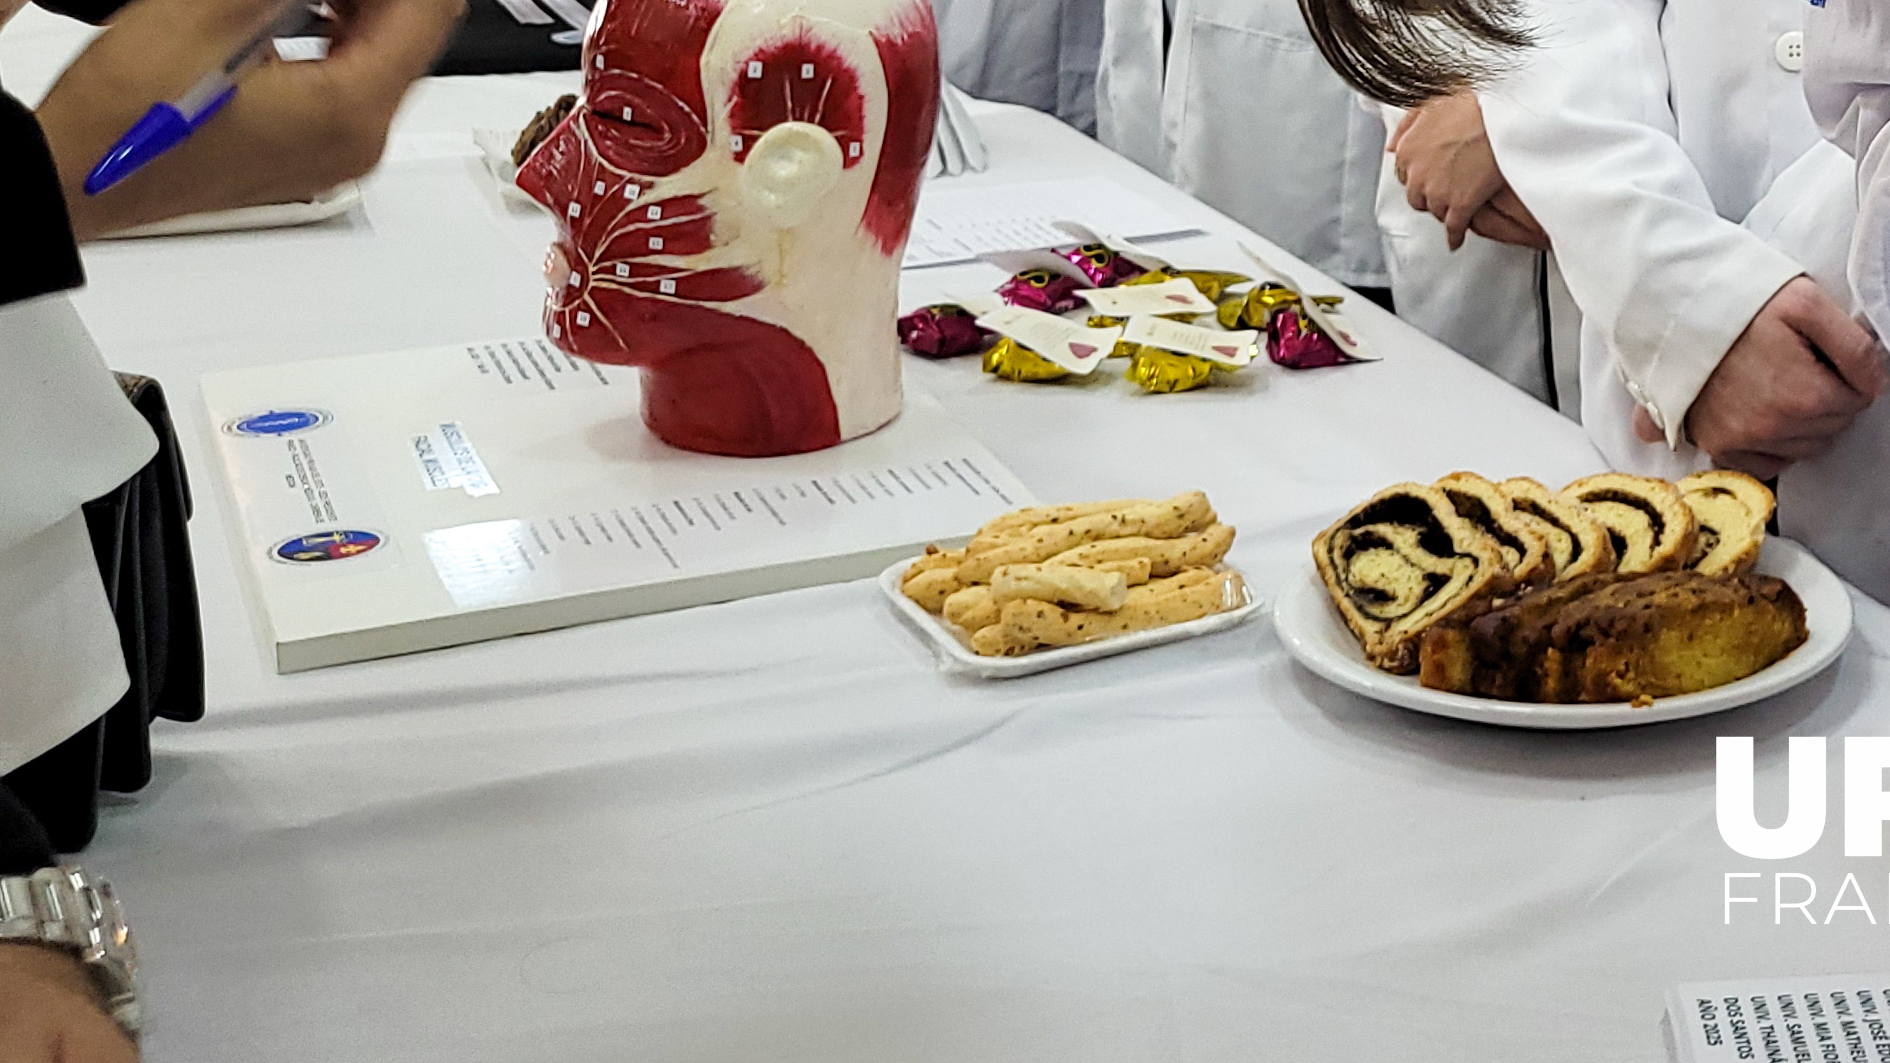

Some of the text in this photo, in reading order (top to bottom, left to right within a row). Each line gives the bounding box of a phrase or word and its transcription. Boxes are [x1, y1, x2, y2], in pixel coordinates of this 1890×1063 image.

[1750, 995, 1772, 1024] UNIV.
[1776, 993, 1799, 1023] UNIV.
[1803, 992, 1827, 1021] UNIV.
[1829, 991, 1853, 1020] UNIV.
[1856, 989, 1880, 1018] UNIV.
[1696, 998, 1724, 1047] AÑO 2025
[1723, 996, 1756, 1060] DOS SANTOS
[1812, 1021, 1834, 1043] MIA
